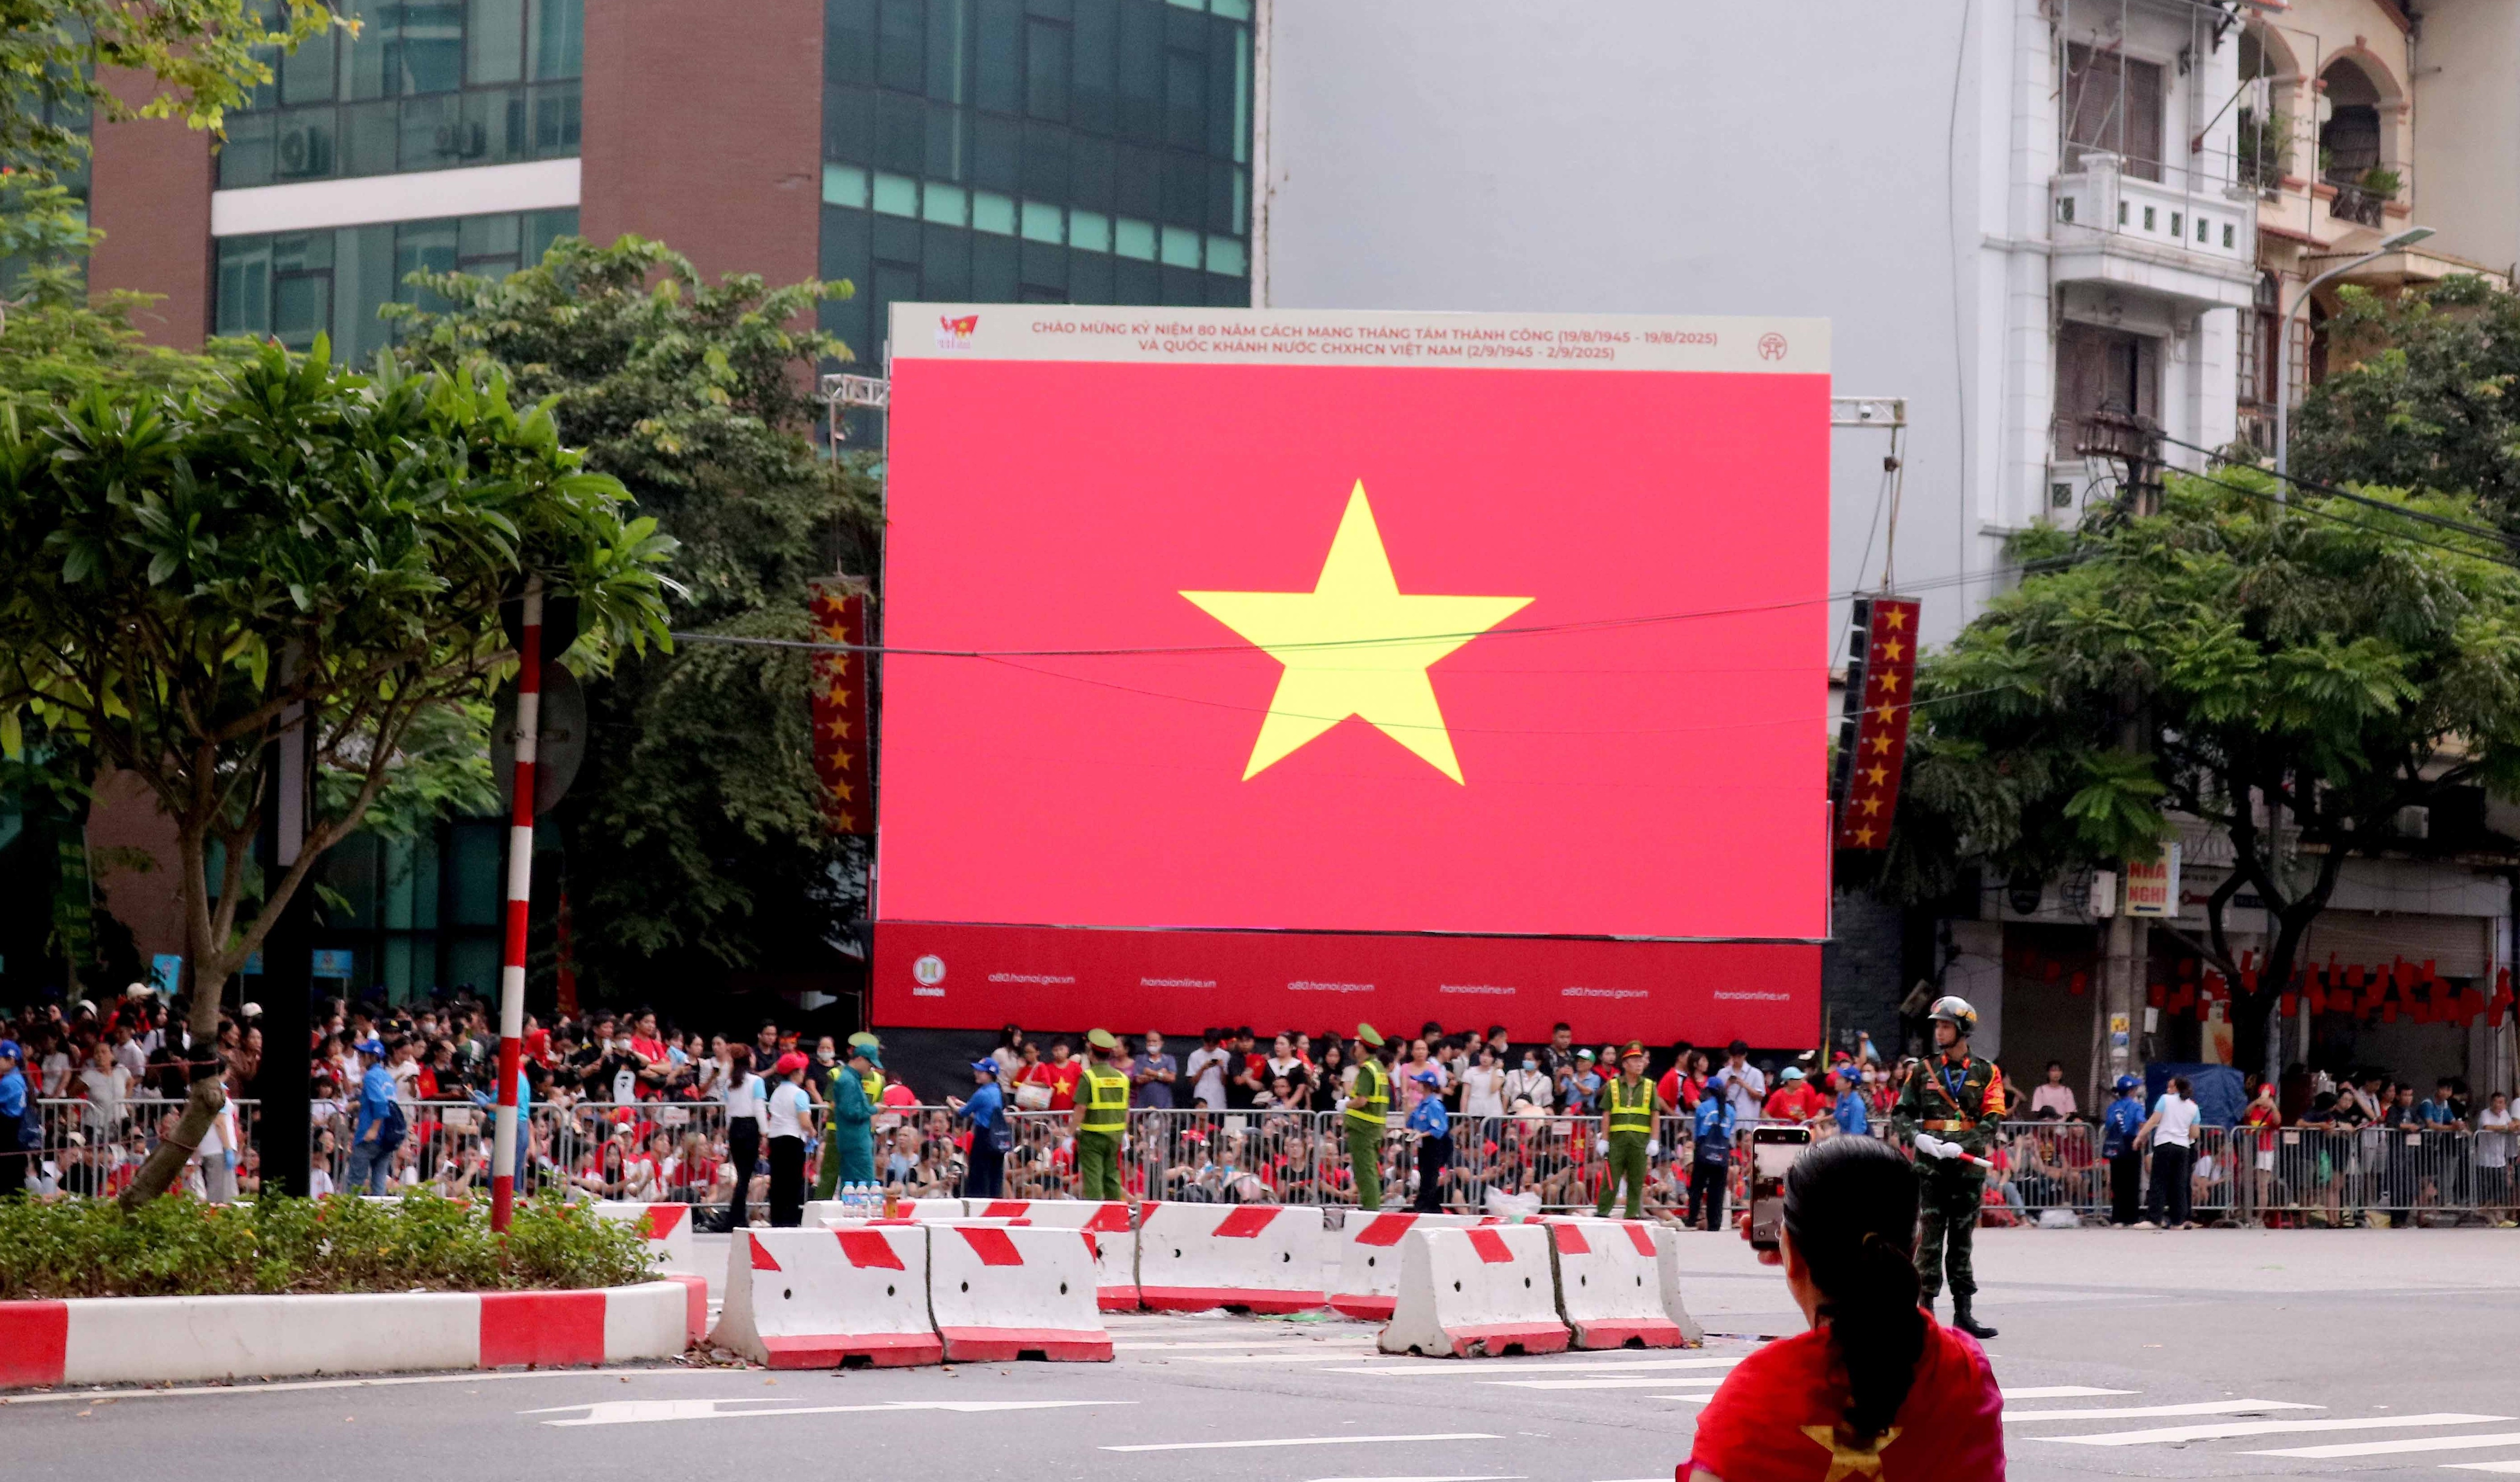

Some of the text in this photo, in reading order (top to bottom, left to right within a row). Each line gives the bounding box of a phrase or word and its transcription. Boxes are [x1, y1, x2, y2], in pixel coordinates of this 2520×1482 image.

[1032, 320, 1076, 334] CHÀO
[1080, 320, 1127, 335] MỪNG
[1155, 321, 1193, 338] NIỆM
[1198, 325, 1216, 336] 80
[1221, 322, 1256, 337] NĂM
[1261, 324, 1303, 338] CÁCH
[1307, 326, 1353, 341] MẠNG
[1358, 325, 1409, 339] THÁNG
[1415, 326, 1447, 340] TÁM
[1452, 327, 1505, 341] THÀNH
[1509, 328, 1554, 342] CÔNG
[1558, 330, 1631, 344] (19/8/1945
[1644, 331, 1718, 346] 19/8/2025)
[1139, 338, 1160, 351] VÀ
[1164, 338, 1207, 353] QUỐC
[1213, 339, 1267, 353] KHÁNH
[1272, 340, 1316, 355] NƯỚC
[1322, 343, 1386, 355] CHXHCN
[1390, 341, 1422, 357] VIỆT
[1427, 344, 1463, 356] NAM
[1467, 344, 1533, 359] (2/9/1945
[1547, 346, 1615, 360] 2/9/2025)
[1141, 977, 1217, 988] hanoionline.vn
[1440, 984, 1516, 994] hanoionline.vn
[1713, 990, 1790, 1001] hanoionline.vn
